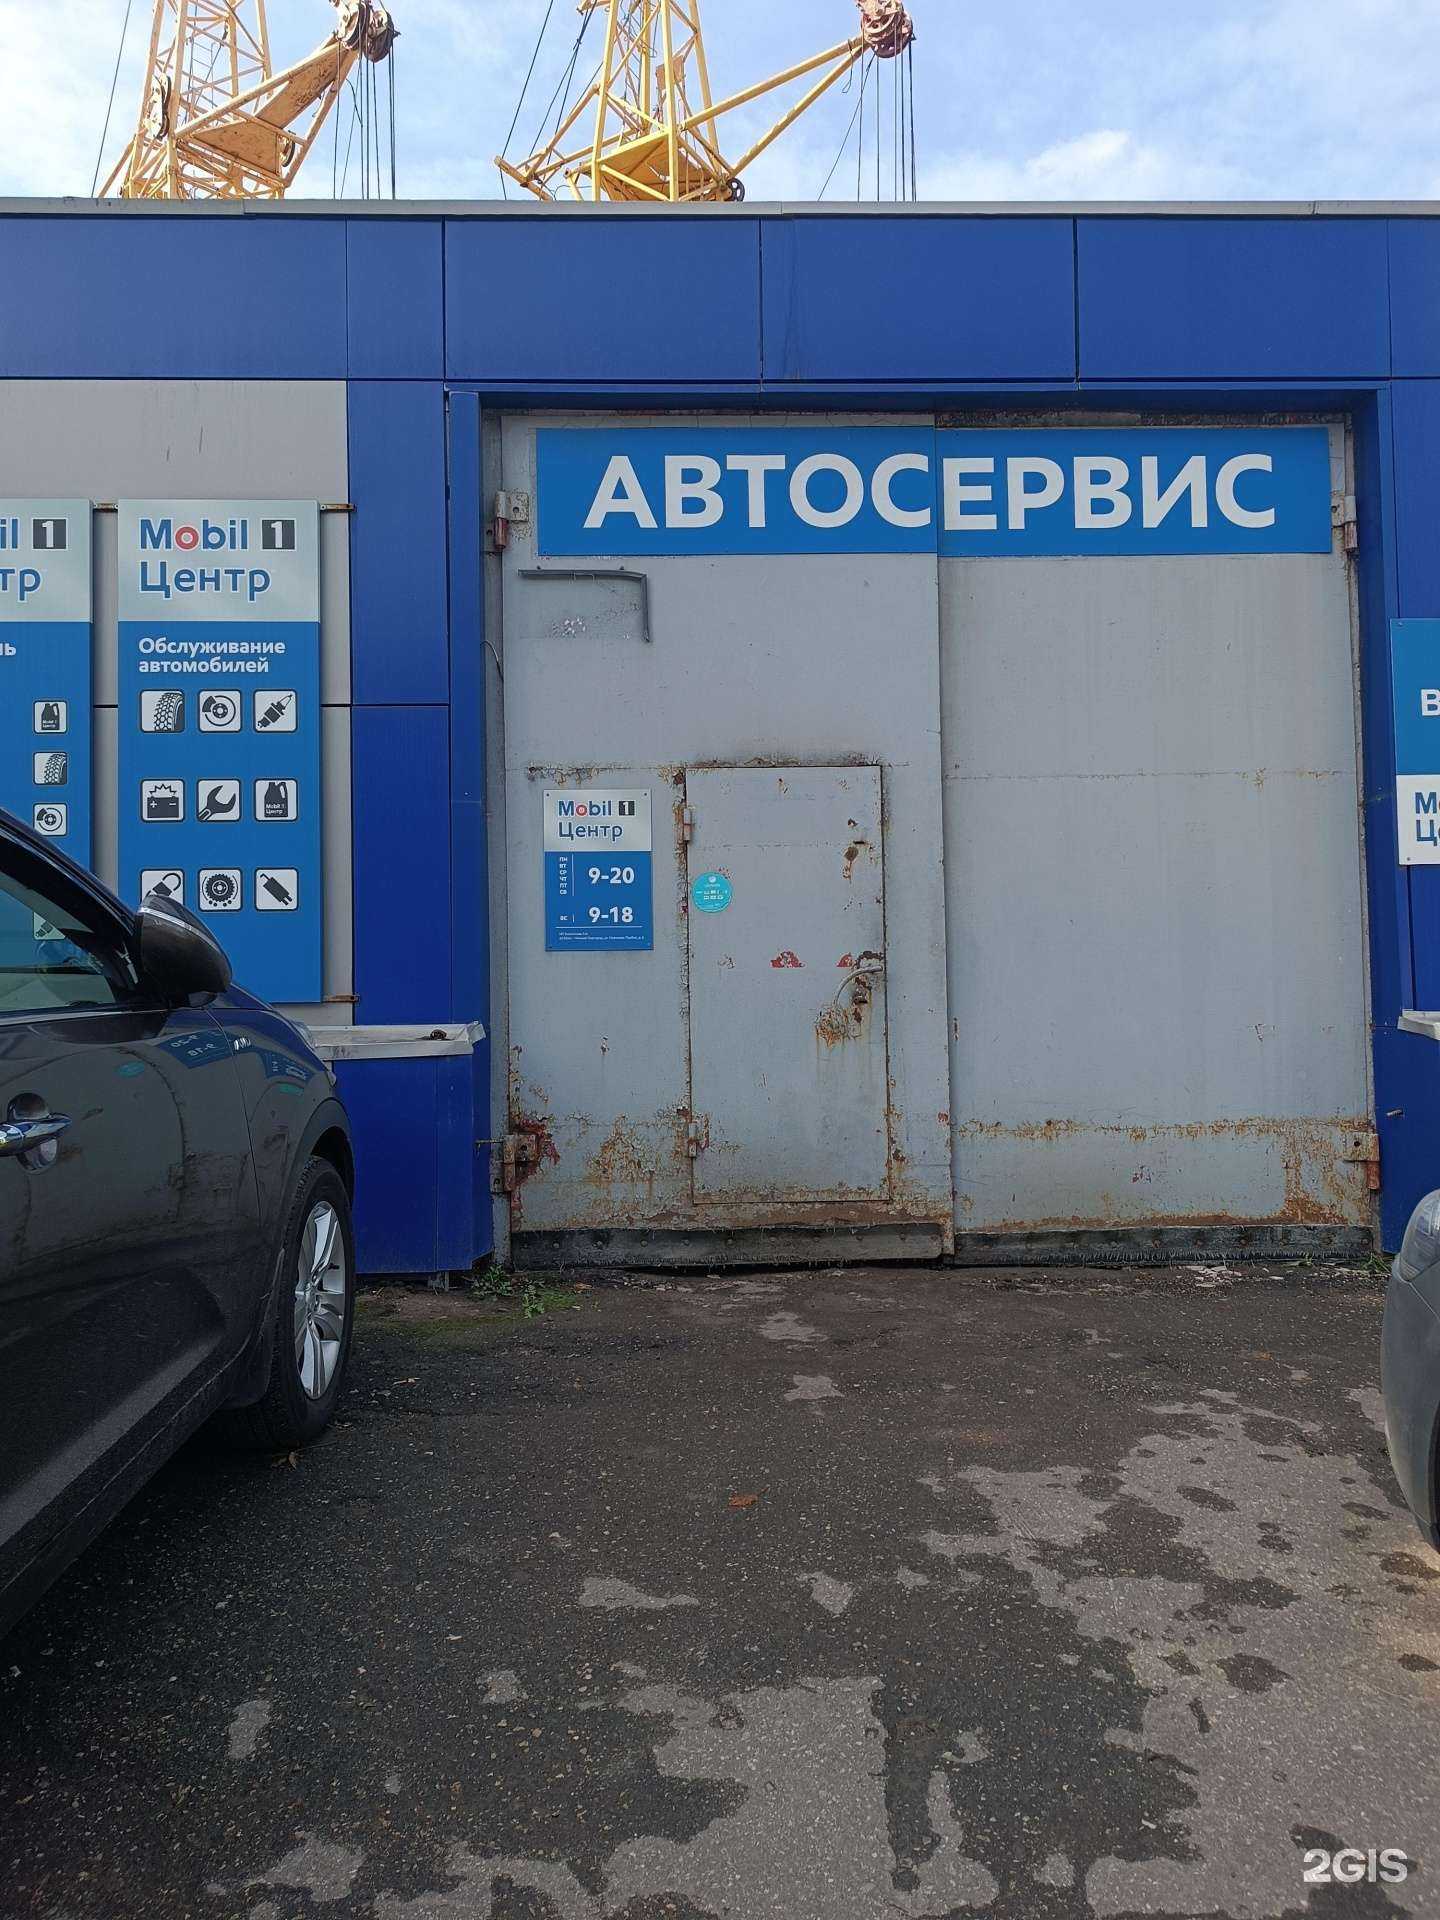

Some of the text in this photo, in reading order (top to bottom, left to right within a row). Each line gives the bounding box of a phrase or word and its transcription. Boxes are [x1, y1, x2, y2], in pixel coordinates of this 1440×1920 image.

[583, 453, 1276, 531] АВТОСЕРВИС
[140, 519, 248, 550] Mobil
[140, 561, 271, 601] Центр
[138, 637, 286, 658] Обслуживание
[138, 656, 269, 673] автомобилей
[559, 800, 612, 816] Mobil
[559, 822, 623, 842] Центр
[588, 867, 635, 884] 9-20
[588, 906, 633, 923] 9-18
